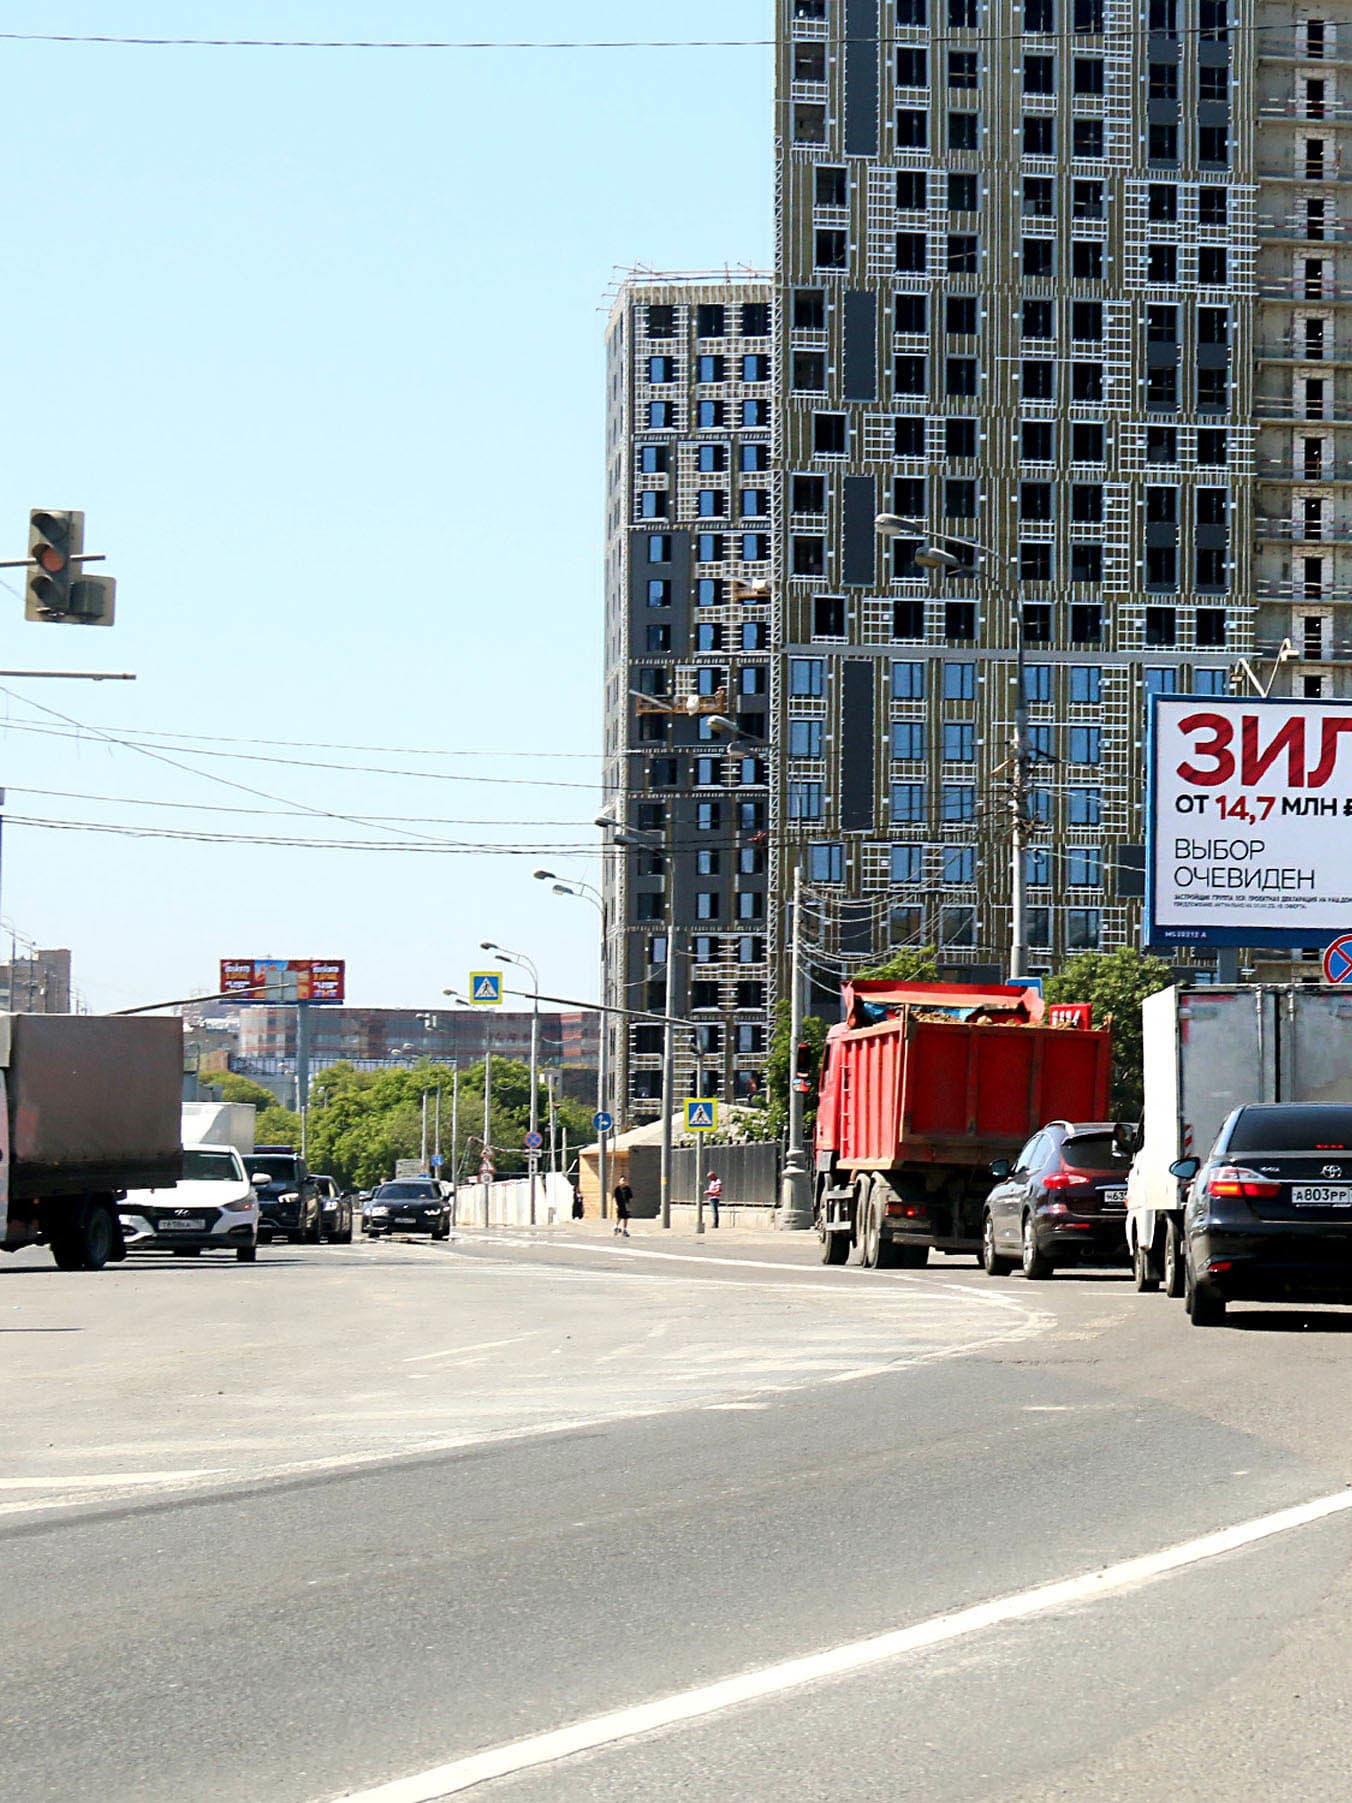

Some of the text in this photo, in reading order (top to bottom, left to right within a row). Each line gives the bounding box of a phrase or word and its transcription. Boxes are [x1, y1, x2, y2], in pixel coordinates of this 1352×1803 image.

[1215, 794, 1275, 826] 14,7
[1281, 797, 1337, 816] МЛН
[1175, 838, 1265, 861] ВЫБОР
[1174, 866, 1315, 891] ОЧЕВИДЕН
